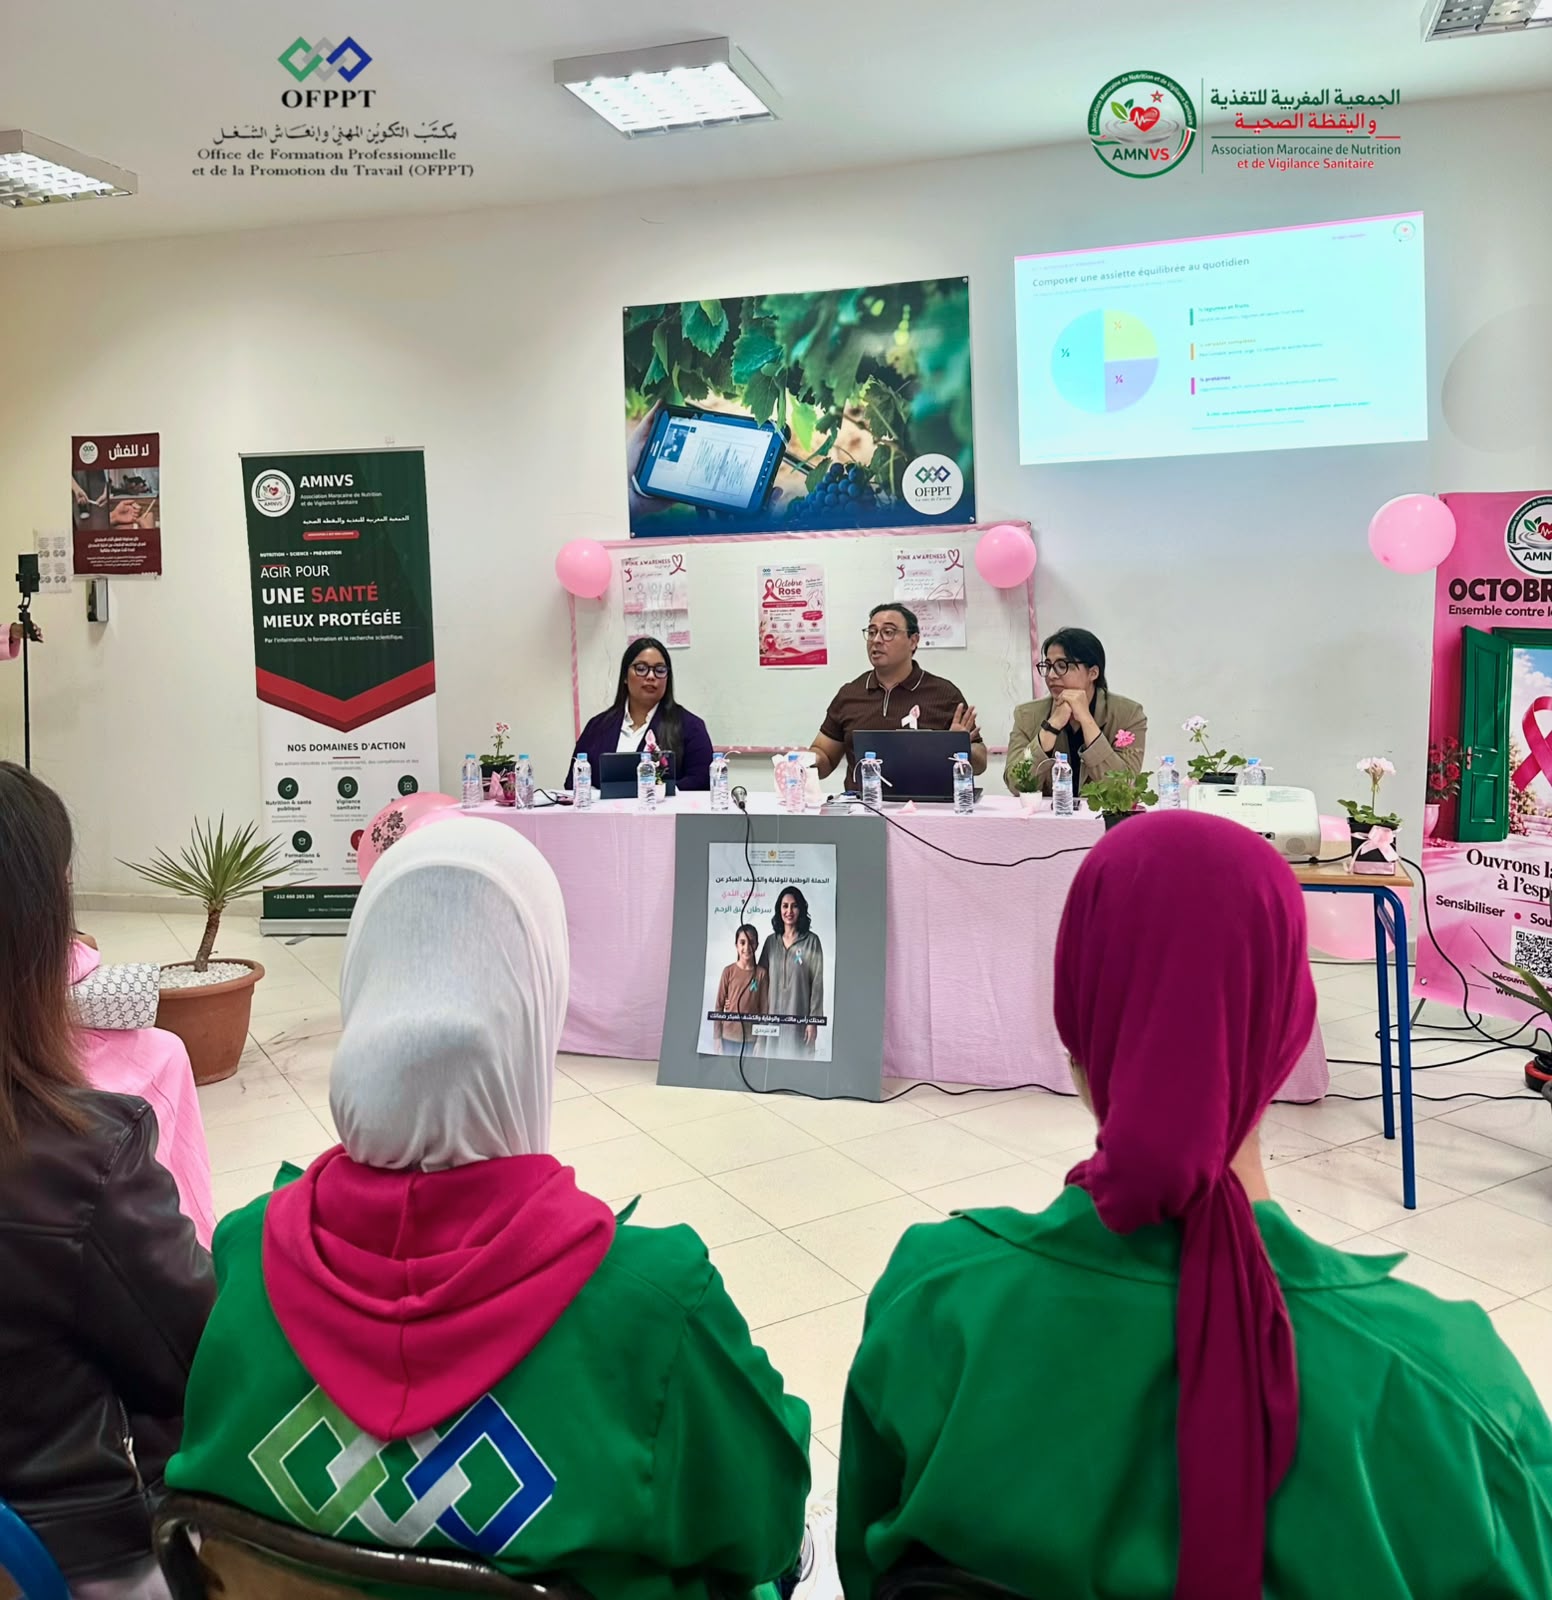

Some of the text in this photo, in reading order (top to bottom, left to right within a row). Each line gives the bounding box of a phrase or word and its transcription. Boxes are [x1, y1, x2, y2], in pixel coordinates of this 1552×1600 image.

[1032, 257, 1250, 287] Composer une assiette équilibrée au quotidien
[108, 443, 150, 460] لا للغش
[300, 474, 354, 488] AMNVS
[914, 486, 952, 497] OFPPT
[260, 565, 330, 578] AGIR POUR
[261, 581, 379, 605] UNE SANTÉ
[1448, 604, 1502, 616] Ensemble
[1505, 606, 1544, 616] contre
[263, 609, 402, 628] MIEUX PROTÉGÉE
[287, 742, 406, 752] NOS DOMAINES D'ACTION
[1466, 848, 1540, 876] Ouvrons
[1497, 874, 1509, 890] à
[1436, 895, 1506, 917] Sensibiliser
